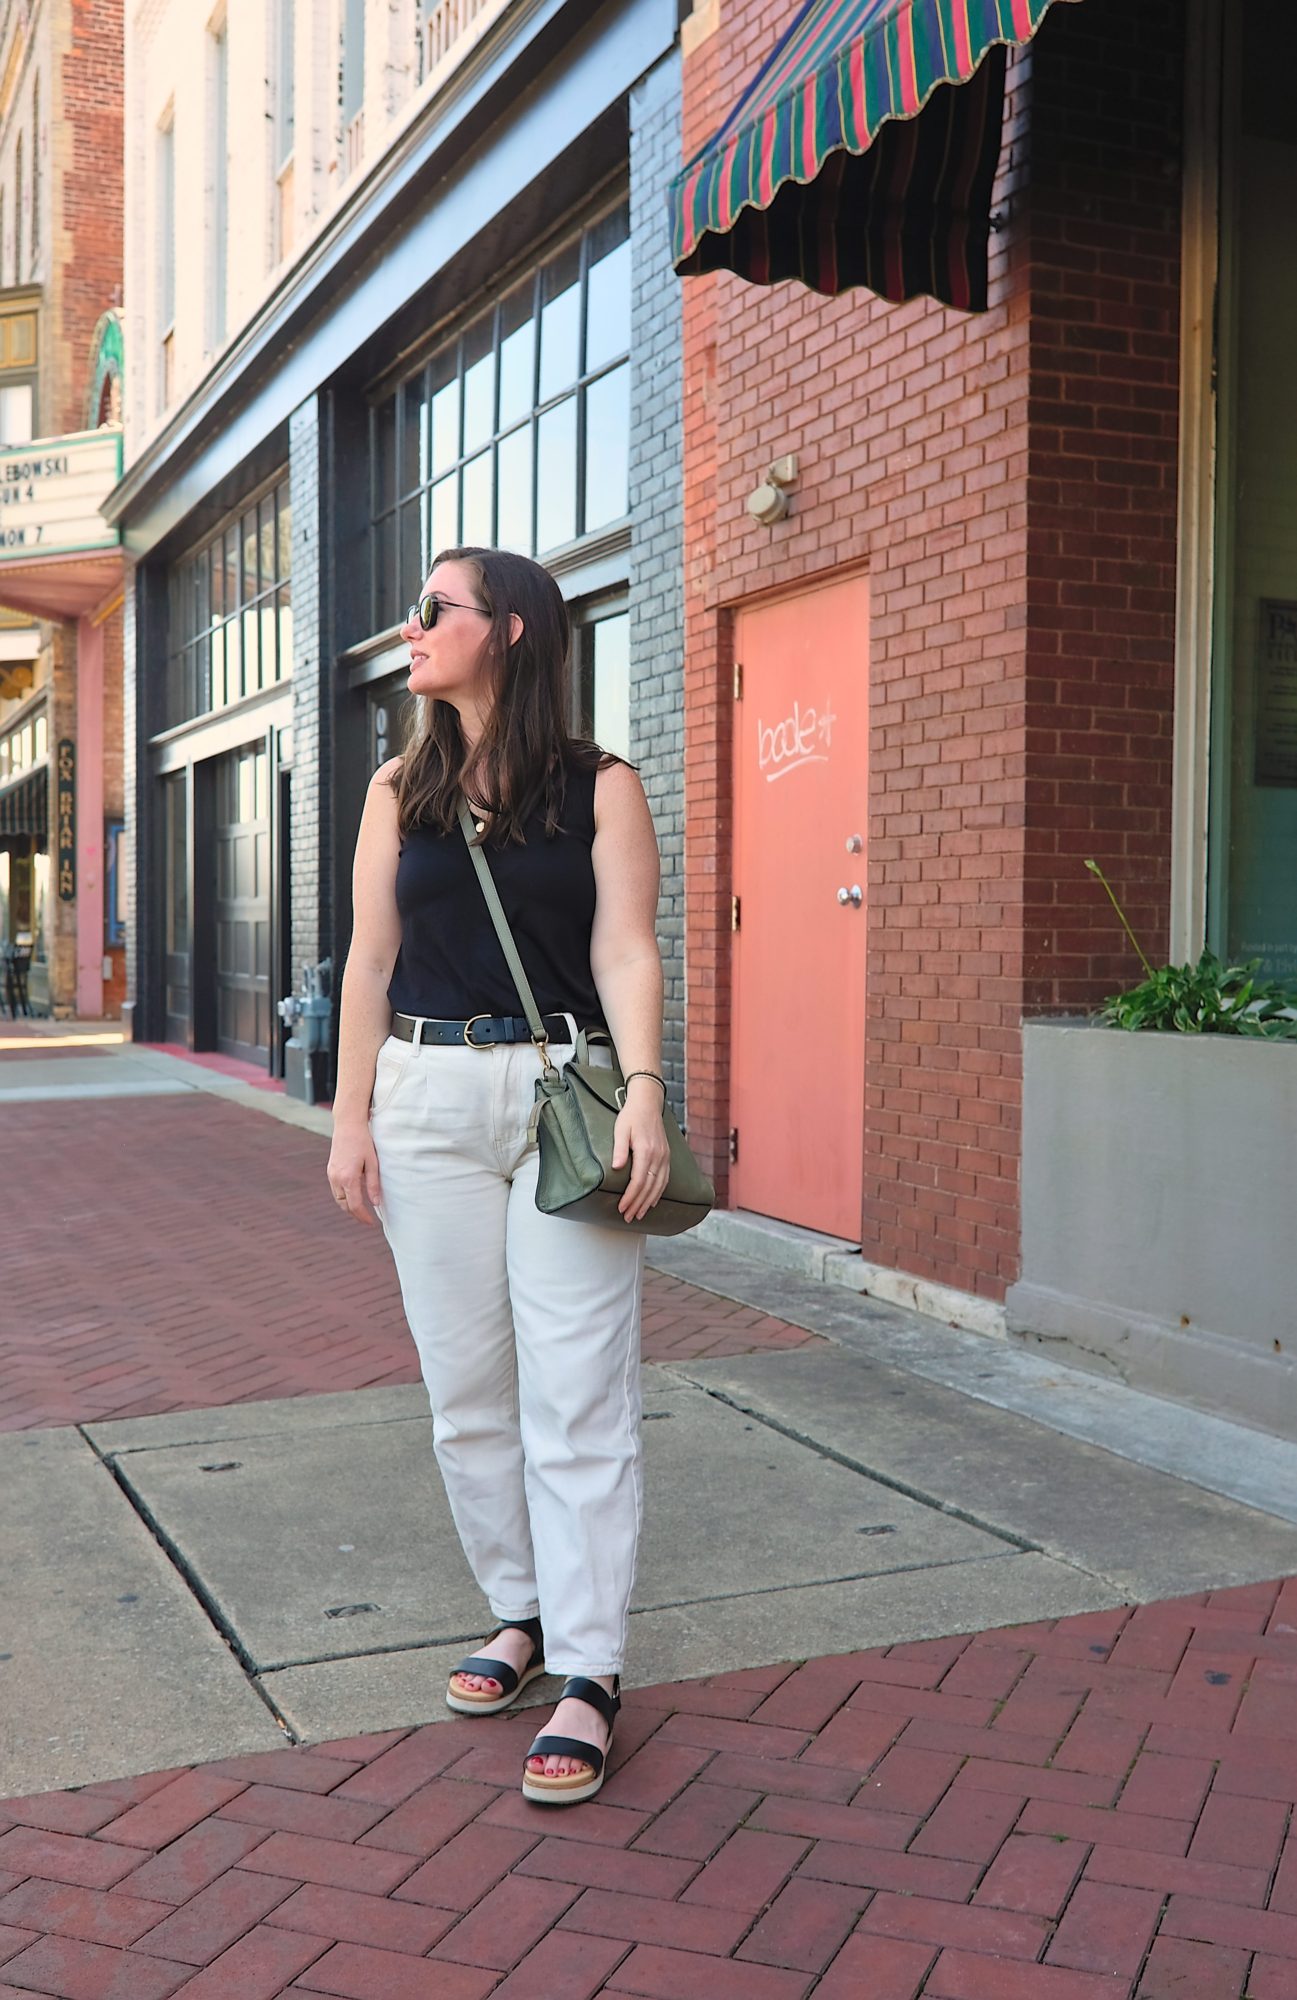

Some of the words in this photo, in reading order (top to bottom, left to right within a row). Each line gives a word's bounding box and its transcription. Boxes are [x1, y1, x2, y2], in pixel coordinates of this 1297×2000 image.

[0, 456, 68, 482] EBOWSKI
[26, 484, 33, 500] 4
[36, 526, 42, 543] 7
[59, 746, 73, 780] FOX
[60, 791, 72, 849] BRIAR
[60, 859, 73, 895] INN
